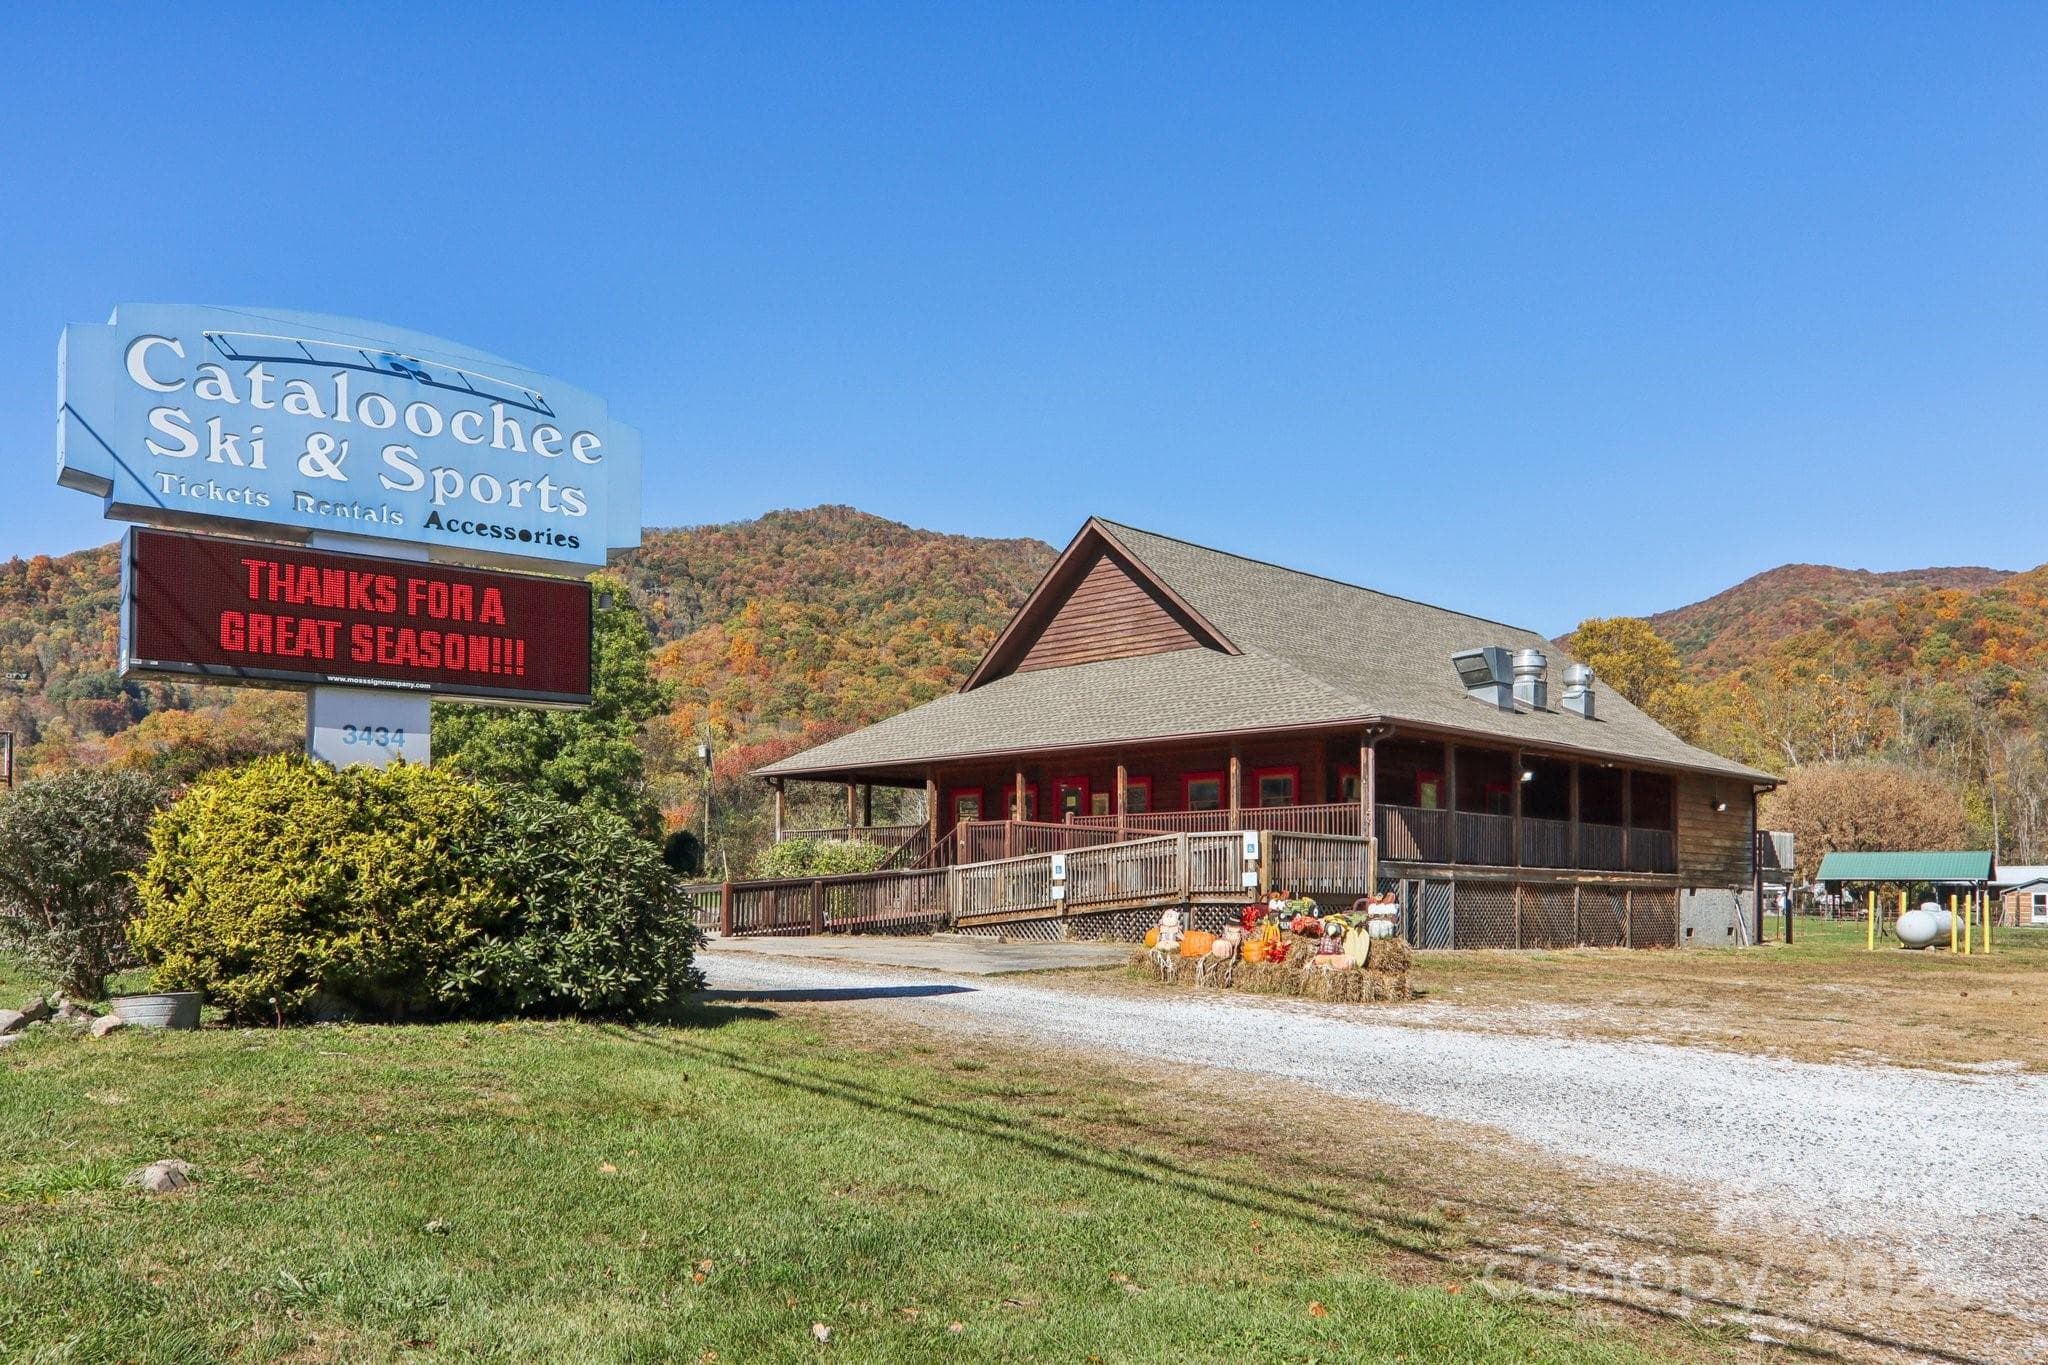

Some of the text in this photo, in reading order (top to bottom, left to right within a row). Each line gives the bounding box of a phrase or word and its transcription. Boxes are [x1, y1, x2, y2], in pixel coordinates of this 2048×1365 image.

[123, 334, 603, 465] Cataloochee
[144, 405, 588, 518] Ski & Sports
[153, 470, 580, 549] Tickets Rentals Accessories
[240, 558, 506, 625] THANKS FOR A
[219, 609, 526, 677] GREAT SEASON!!!
[326, 675, 432, 690] www.mosssigncompany.com
[342, 723, 406, 748] 3434
